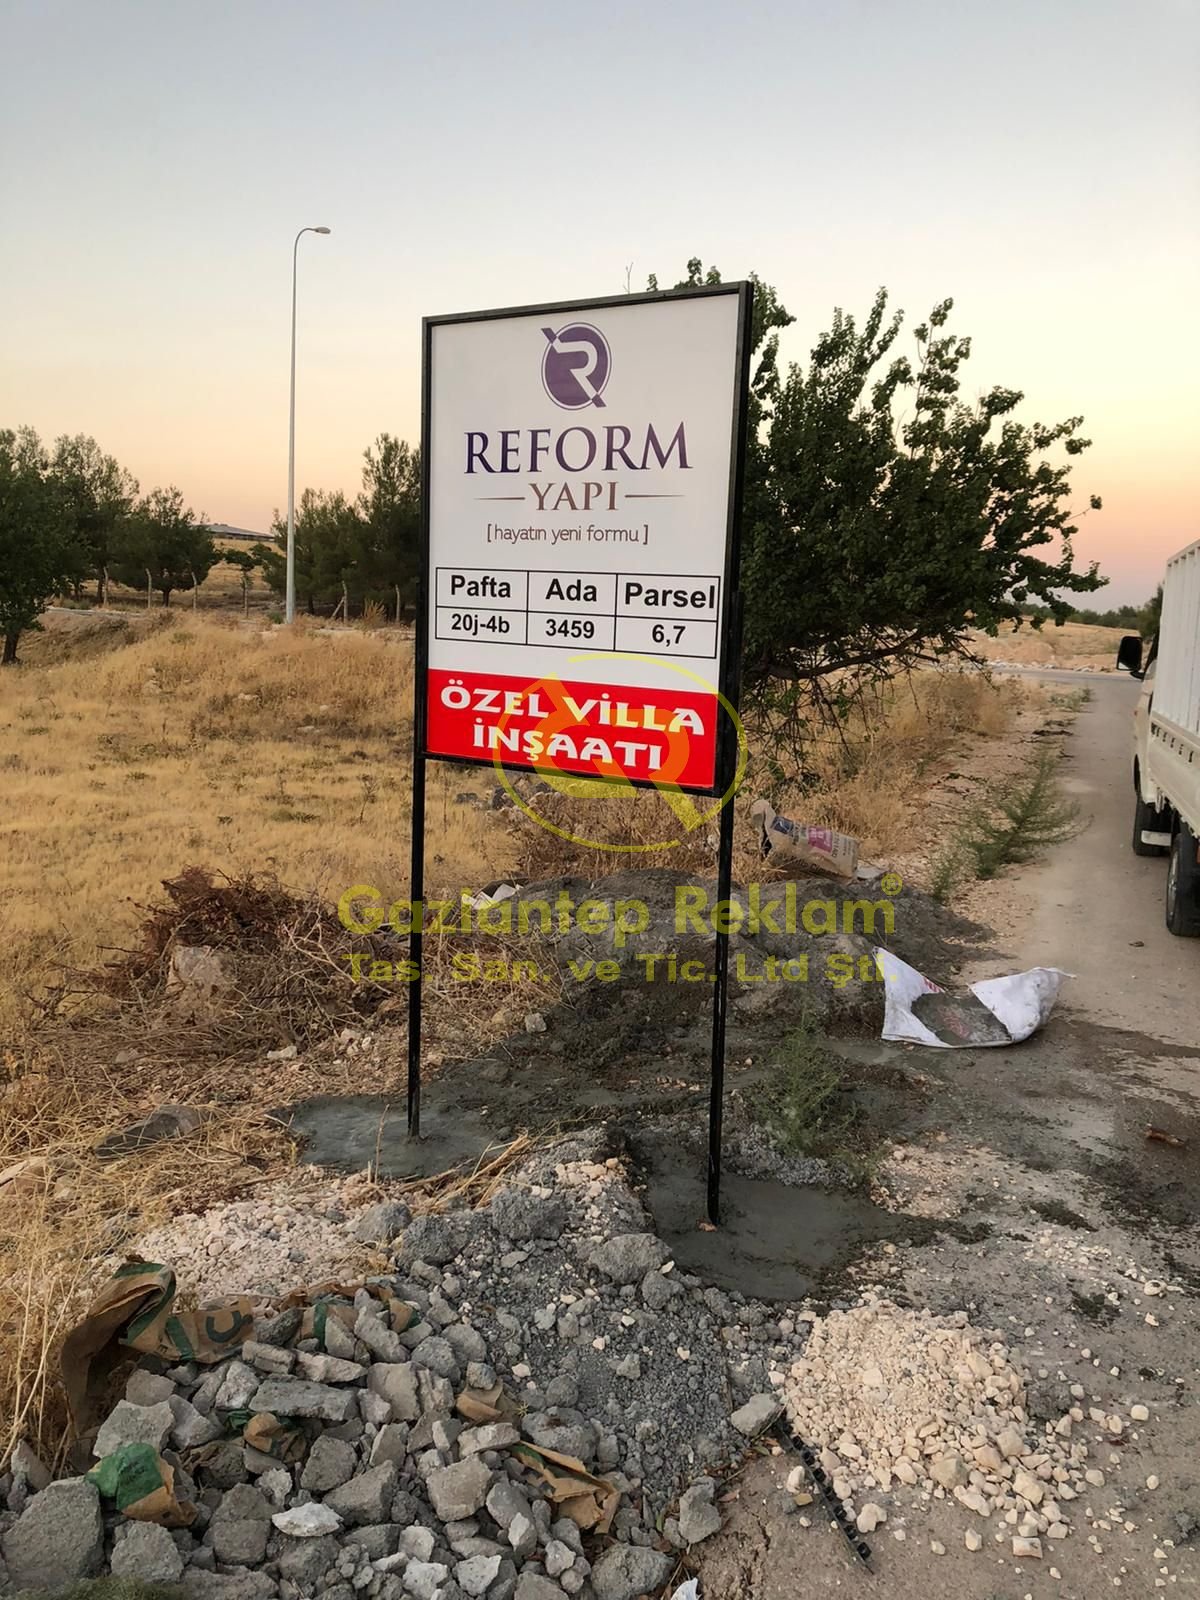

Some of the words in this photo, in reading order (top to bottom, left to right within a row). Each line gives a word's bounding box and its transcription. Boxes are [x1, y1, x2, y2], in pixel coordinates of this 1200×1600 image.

[464, 421, 693, 474] REFORM
[528, 481, 619, 511] YAPI
[551, 525, 581, 544] yeni
[450, 574, 511, 598] Pafta
[545, 578, 597, 602] Ada
[624, 582, 716, 609] Parsel
[451, 613, 510, 636] 20j-4b
[545, 619, 595, 639] 3459
[652, 625, 686, 647] 6,7
[440, 678, 549, 719] ÖZEL
[561, 692, 705, 736] VİLLA
[472, 717, 662, 771] İNŞAATI
